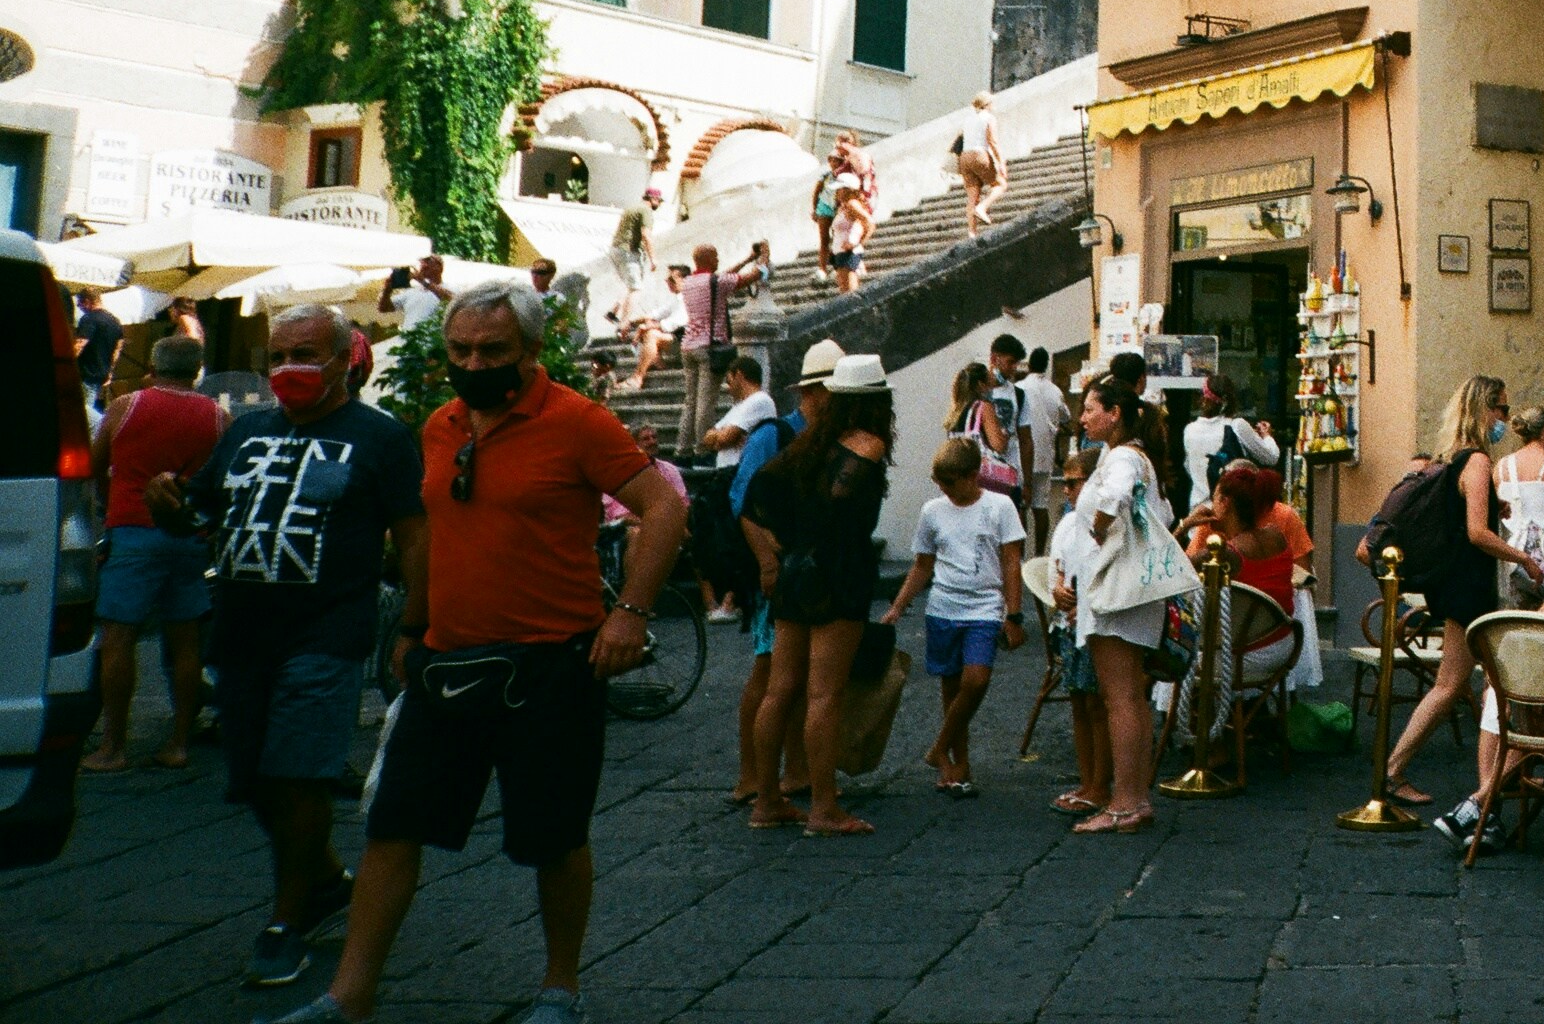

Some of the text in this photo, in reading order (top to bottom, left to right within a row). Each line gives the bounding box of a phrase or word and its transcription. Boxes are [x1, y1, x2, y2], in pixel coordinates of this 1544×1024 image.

[1196, 80, 1241, 111] Sapori
[1246, 70, 1301, 101] d'Amalfi
[156, 162, 267, 190] RISTORANTE
[170, 182, 251, 206] PIZZERIA
